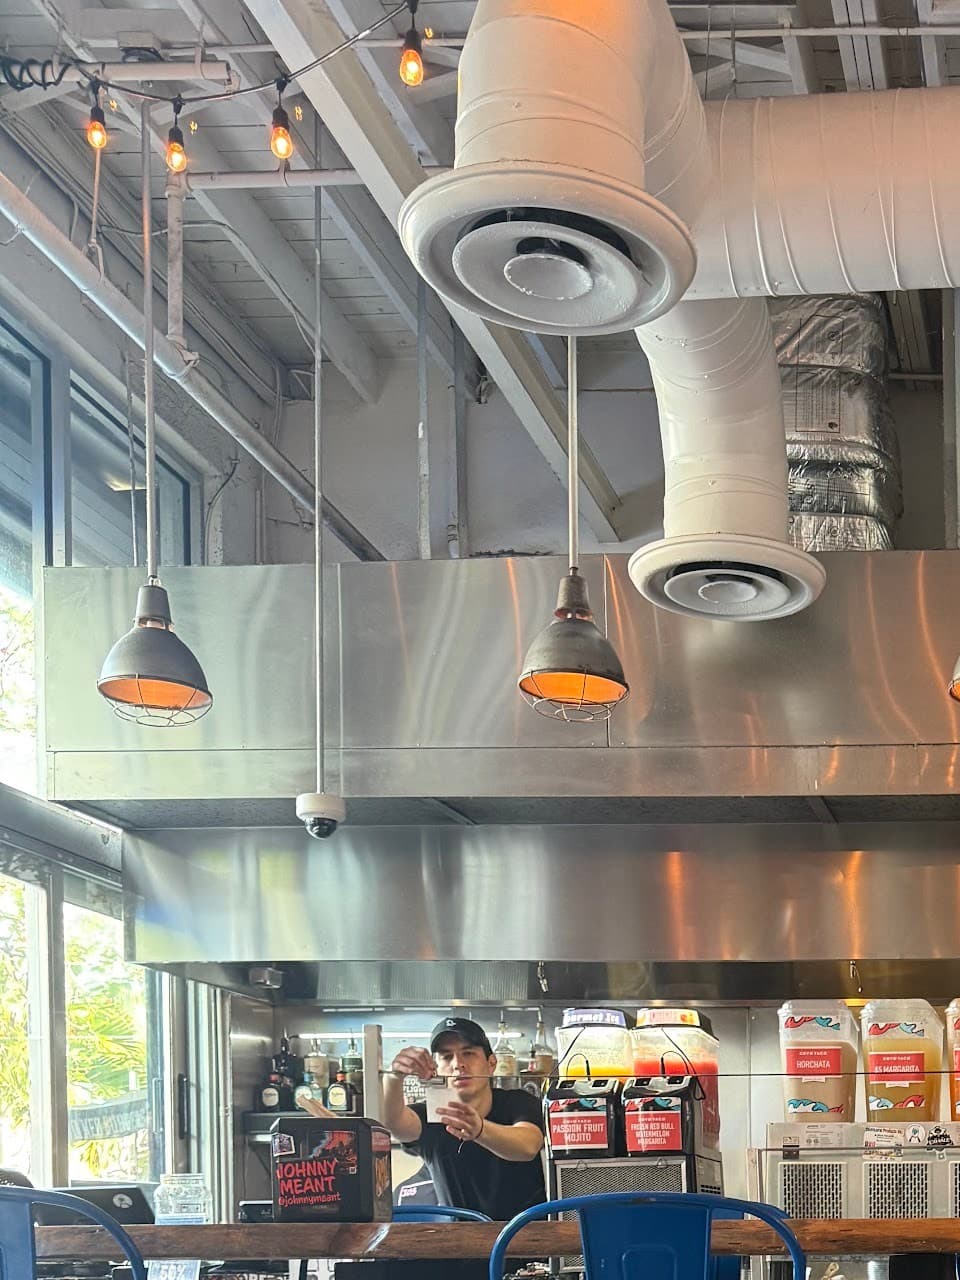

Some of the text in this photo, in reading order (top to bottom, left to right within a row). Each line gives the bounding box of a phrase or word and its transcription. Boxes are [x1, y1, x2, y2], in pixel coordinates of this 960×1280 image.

[796, 1060, 831, 1069] HORCHATA
[553, 1123, 605, 1133] PASSION FRUIT
[661, 1122, 675, 1130] BULL
[564, 1132, 592, 1142] MOJITO
[277, 1159, 338, 1178] JOHNNY
[280, 1176, 336, 1195] MEANT
